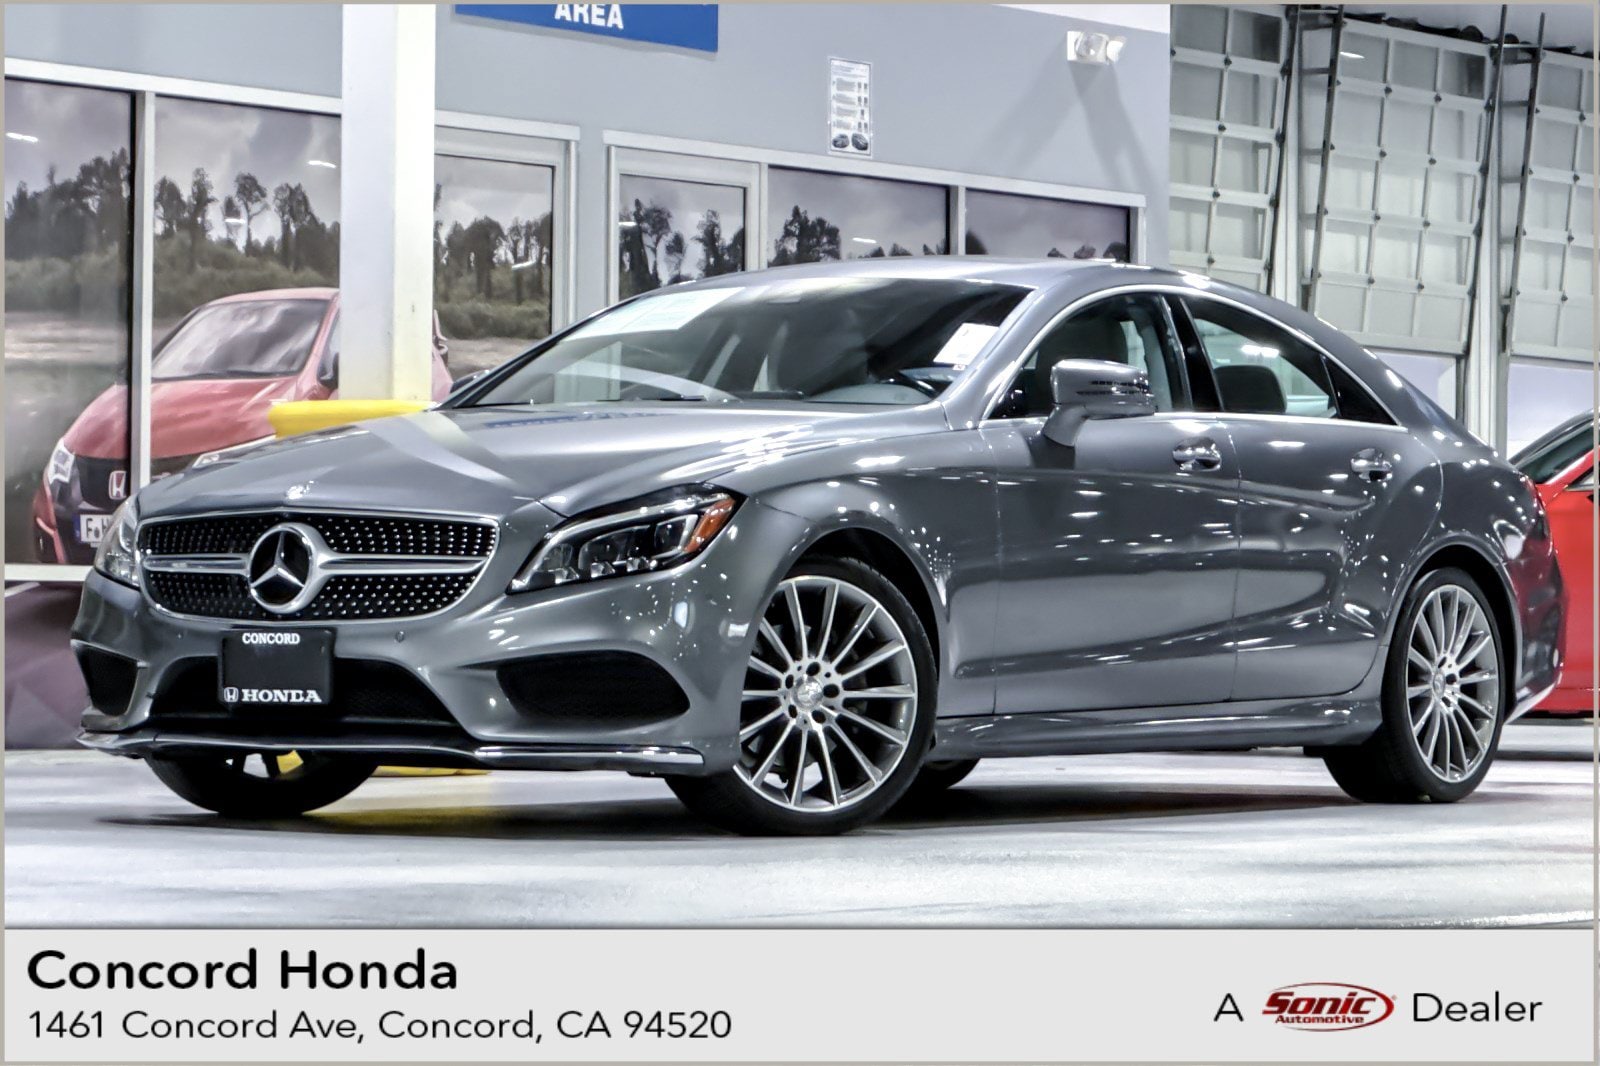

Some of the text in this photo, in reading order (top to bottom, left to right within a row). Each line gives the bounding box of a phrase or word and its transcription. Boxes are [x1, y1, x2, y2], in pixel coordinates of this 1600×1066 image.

[554, 5, 624, 30] AREA
[242, 632, 301, 645] CONCORD
[241, 688, 323, 703] HONDA
